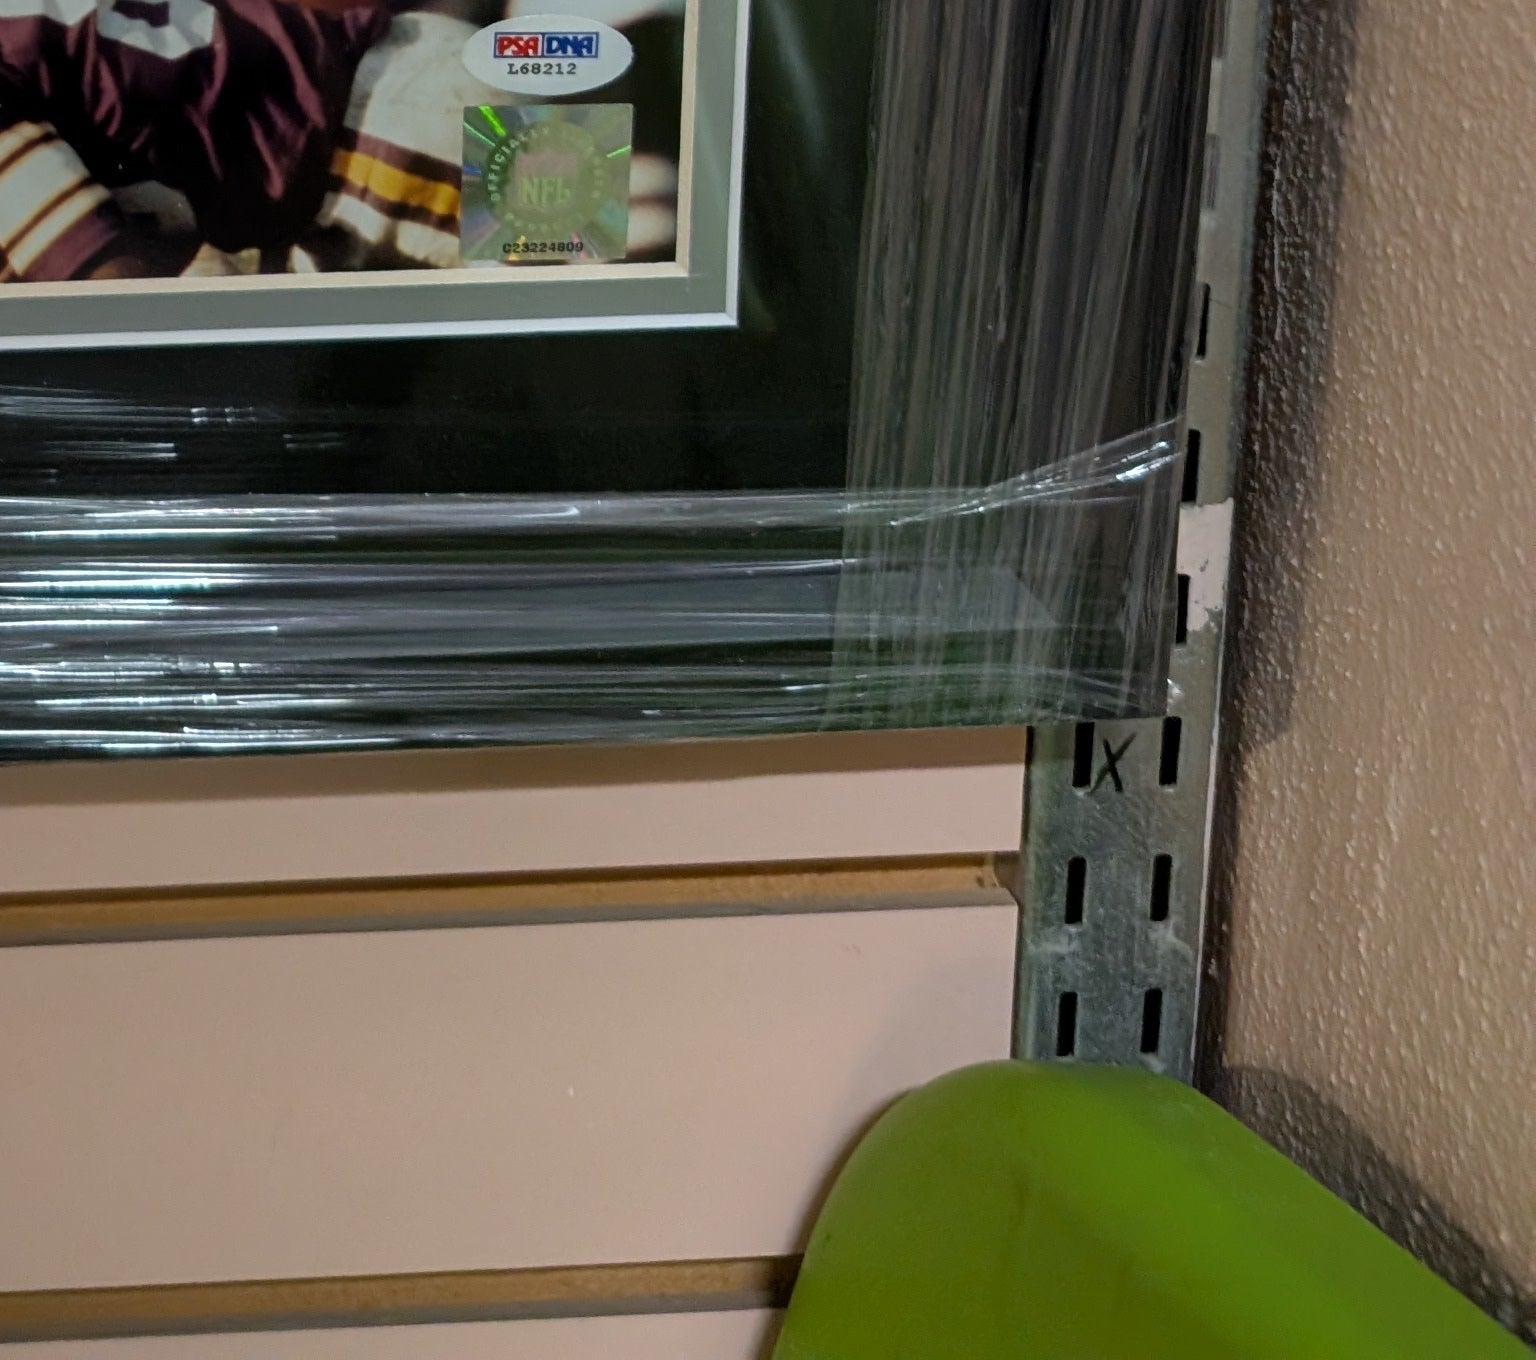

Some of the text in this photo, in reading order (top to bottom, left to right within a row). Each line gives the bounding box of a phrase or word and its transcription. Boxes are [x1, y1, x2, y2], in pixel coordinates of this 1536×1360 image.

[497, 35, 594, 57] PSA DNA
[507, 62, 577, 75] L68212
